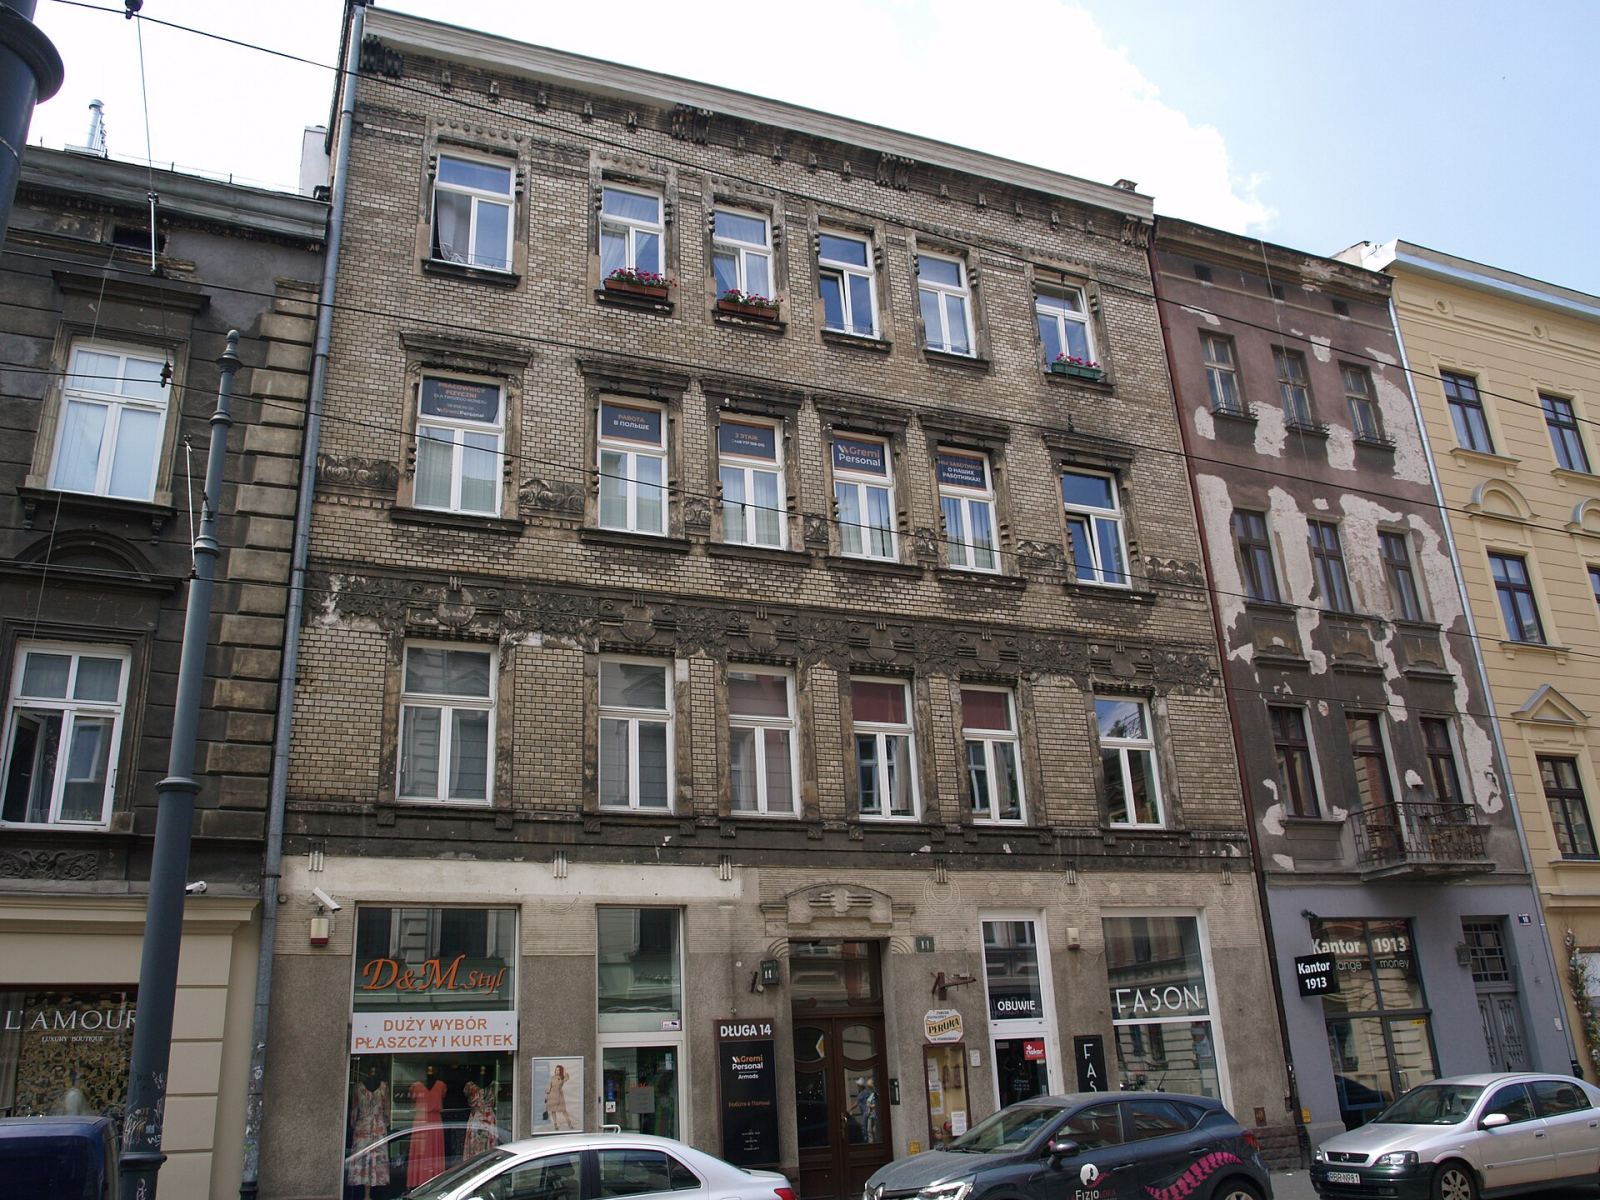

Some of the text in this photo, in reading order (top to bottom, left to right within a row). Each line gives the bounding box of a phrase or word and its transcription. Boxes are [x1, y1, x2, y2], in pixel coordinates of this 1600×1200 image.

[618, 414, 646, 423] РАБОТА
[620, 420, 650, 430] ПОЛЬШЕ
[850, 446, 880, 458] Gremi
[839, 453, 881, 467] Personal
[1311, 937, 1407, 954] Kantor 1913
[1297, 961, 1331, 974] Kantor
[1335, 959, 1409, 972] ange money
[362, 953, 507, 995] D&M Styl
[1305, 976, 1328, 989] 1913
[997, 1000, 1036, 1011] OBUWIE
[383, 1016, 487, 1031] DUŻY WYBÓR
[720, 1023, 772, 1037] DŁUGA 14
[928, 1017, 960, 1034] PERUKA
[355, 1034, 513, 1049] PŁASZCZY I KURTEK
[740, 1054, 763, 1063] Gremi
[732, 1061, 764, 1070] Personal
